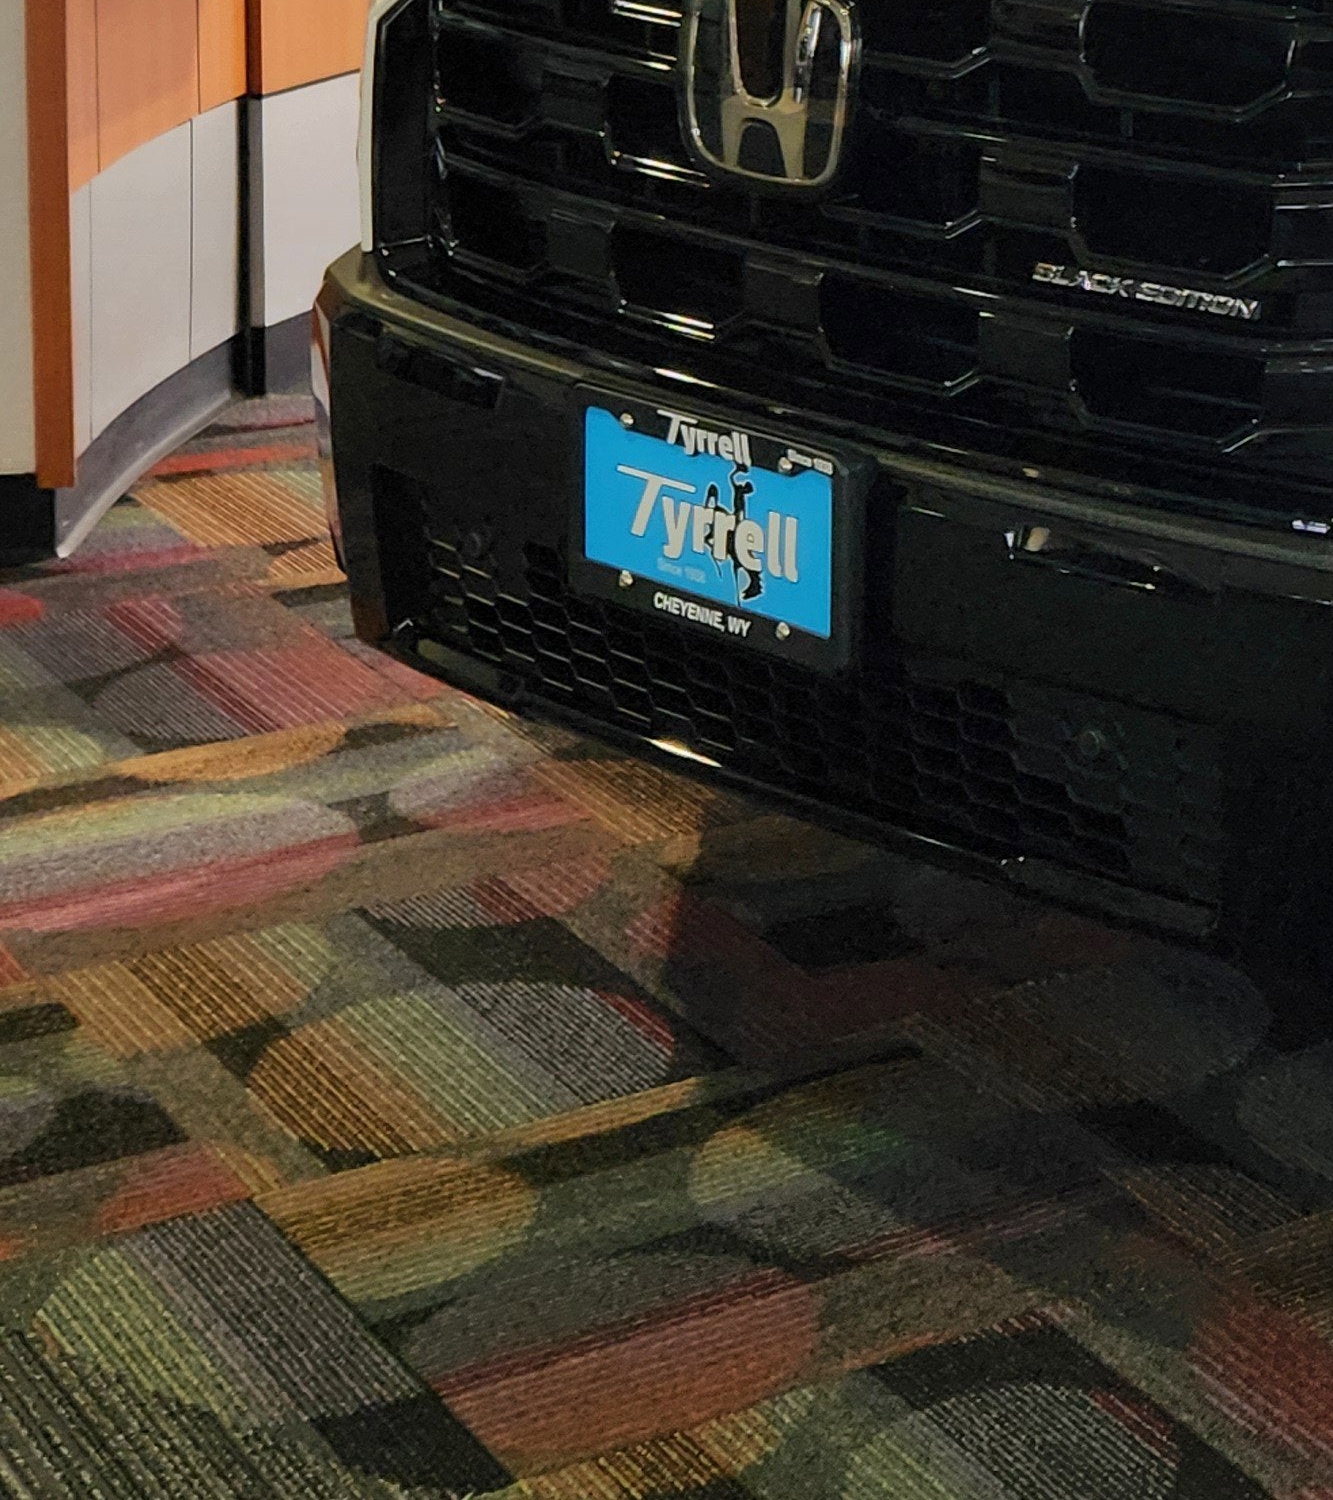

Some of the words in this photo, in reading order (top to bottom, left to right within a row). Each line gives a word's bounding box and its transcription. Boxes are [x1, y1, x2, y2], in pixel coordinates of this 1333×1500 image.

[1032, 262, 1134, 298] BLACK
[1135, 281, 1262, 320] EDITION
[656, 409, 752, 468] Tyrrell
[616, 464, 799, 583] Tyrrell
[653, 591, 725, 632] CHEYENNE,
[727, 615, 752, 638] WY
